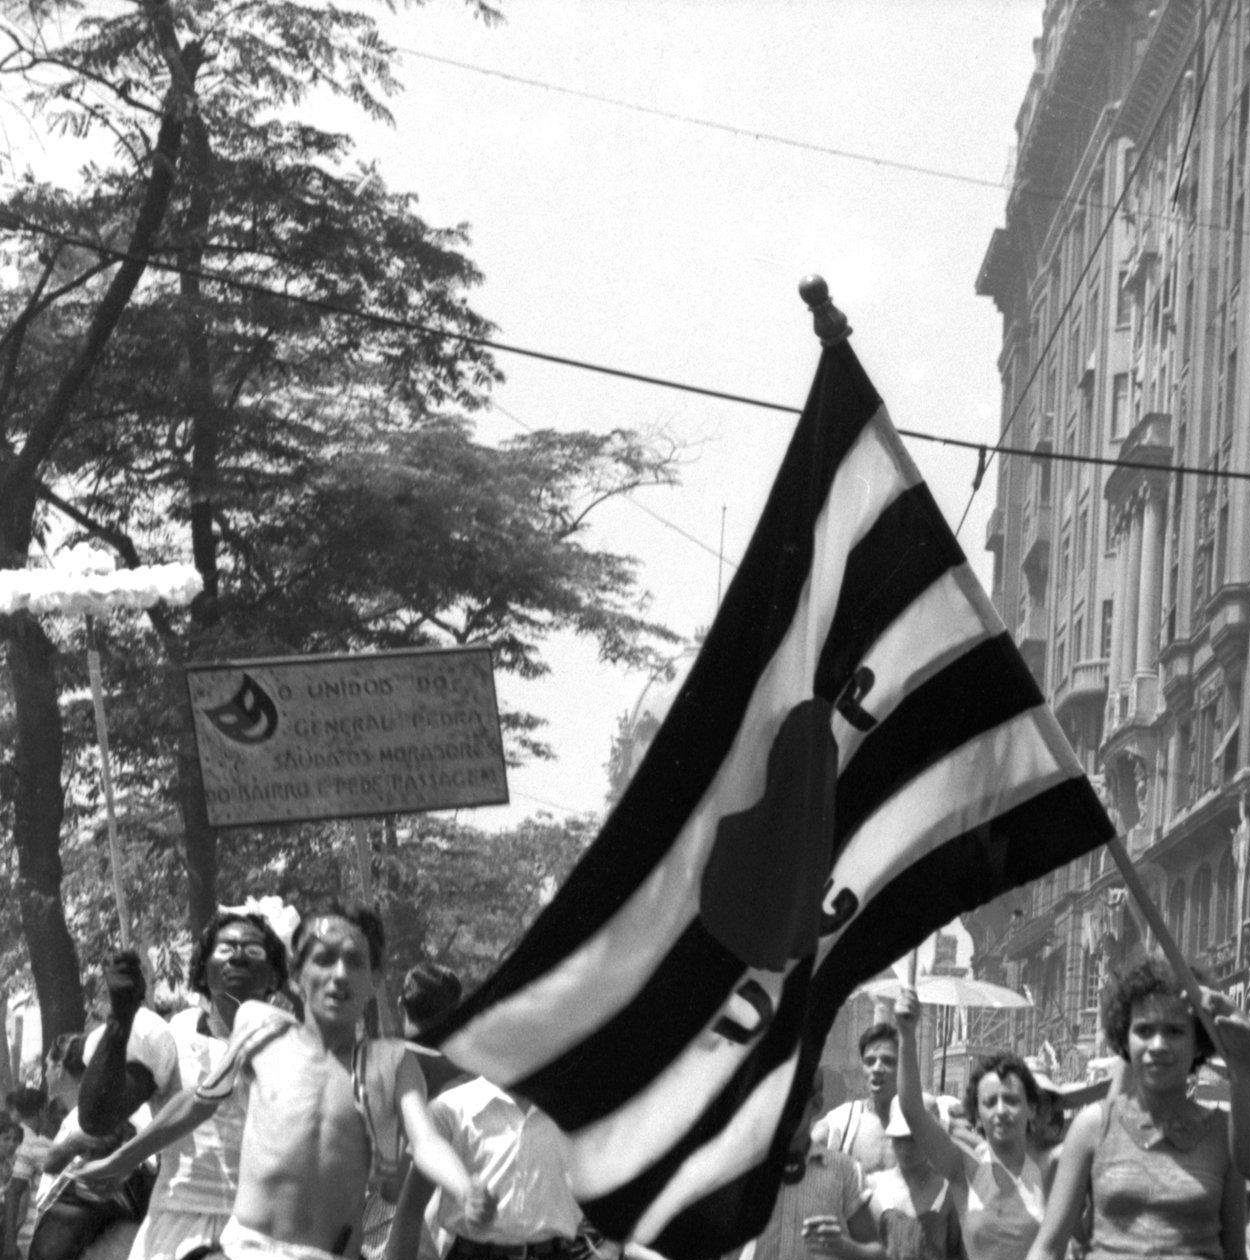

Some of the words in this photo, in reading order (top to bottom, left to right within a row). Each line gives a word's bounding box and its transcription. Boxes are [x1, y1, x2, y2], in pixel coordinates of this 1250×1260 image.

[307, 675, 393, 699] UNIDOS
[294, 713, 394, 738] GENERAL
[412, 708, 482, 730] PEDRA
